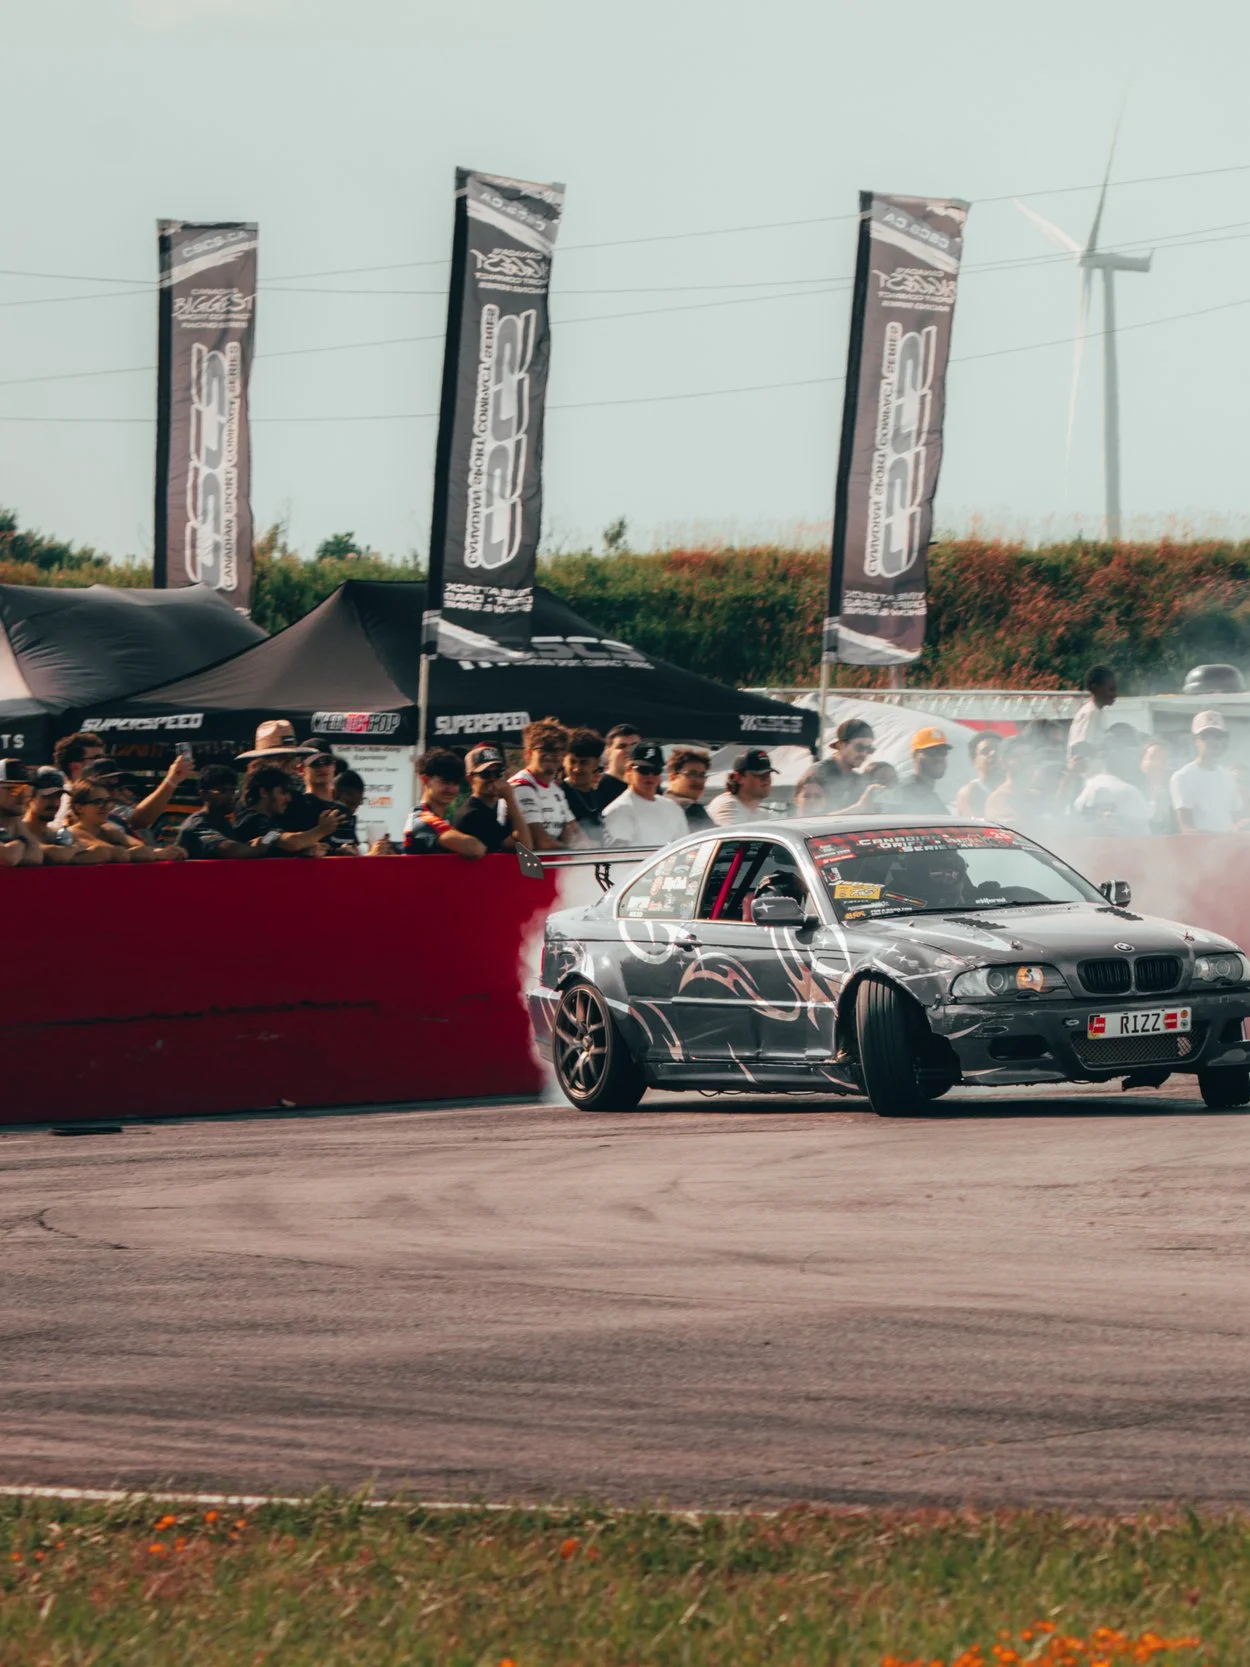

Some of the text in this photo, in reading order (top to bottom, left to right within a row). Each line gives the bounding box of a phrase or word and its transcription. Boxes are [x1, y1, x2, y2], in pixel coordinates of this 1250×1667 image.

[223, 345, 239, 588] CANADIAN SPORT COMPACT SERIES
[80, 713, 205, 732] SUPERSPEED
[432, 711, 531, 735] SUPERSPEED
[857, 834, 943, 846] CANADIAN
[879, 840, 924, 849] DRIFT
[1120, 1013, 1161, 1034] RIZZ
